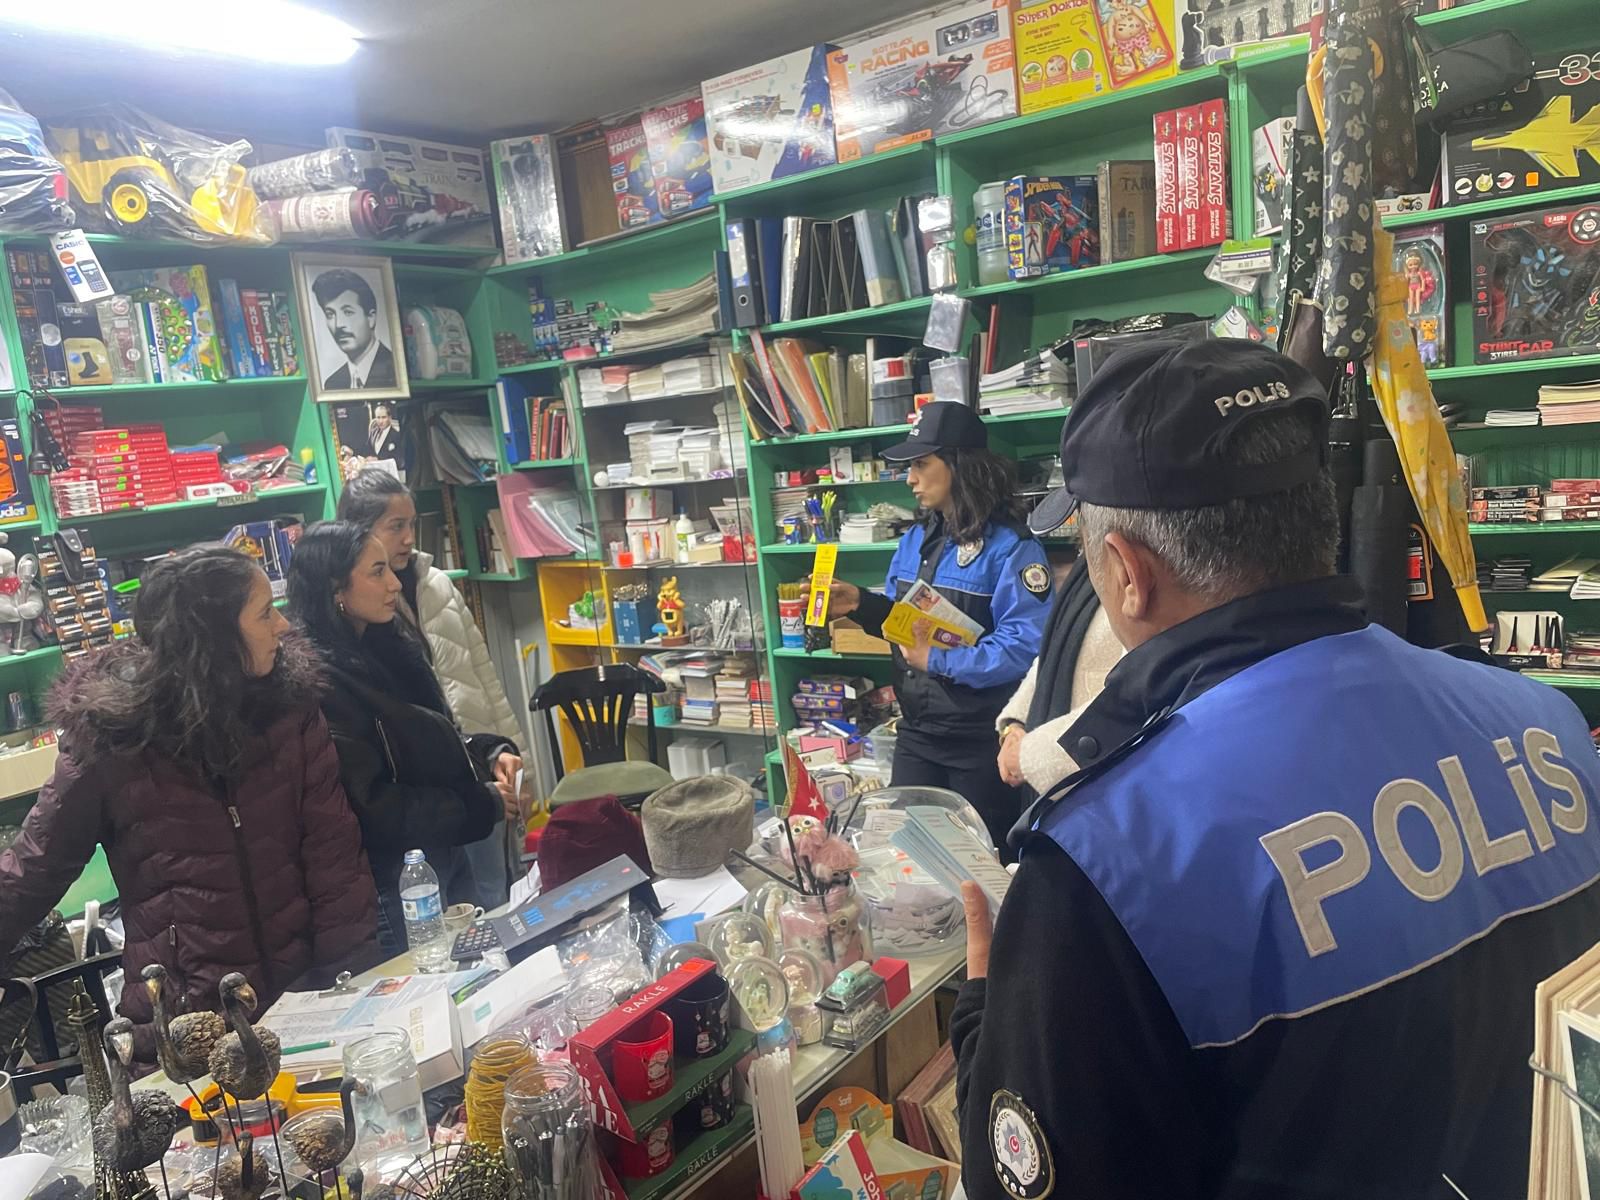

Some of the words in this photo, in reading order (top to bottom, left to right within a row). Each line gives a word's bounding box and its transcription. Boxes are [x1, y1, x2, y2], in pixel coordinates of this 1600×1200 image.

[861, 40, 929, 74] RACING
[1161, 142, 1176, 214] SATRANÇ
[1184, 136, 1199, 210] SATRANÇ
[1207, 132, 1222, 206] SATRANÇ
[1479, 341, 1524, 354] STUNT
[1519, 340, 1554, 356] CAR
[1259, 727, 1588, 958] POLİS
[622, 984, 669, 1015] RAKLE
[684, 1072, 715, 1101] RAKLE
[687, 1144, 719, 1176] RAKLE
